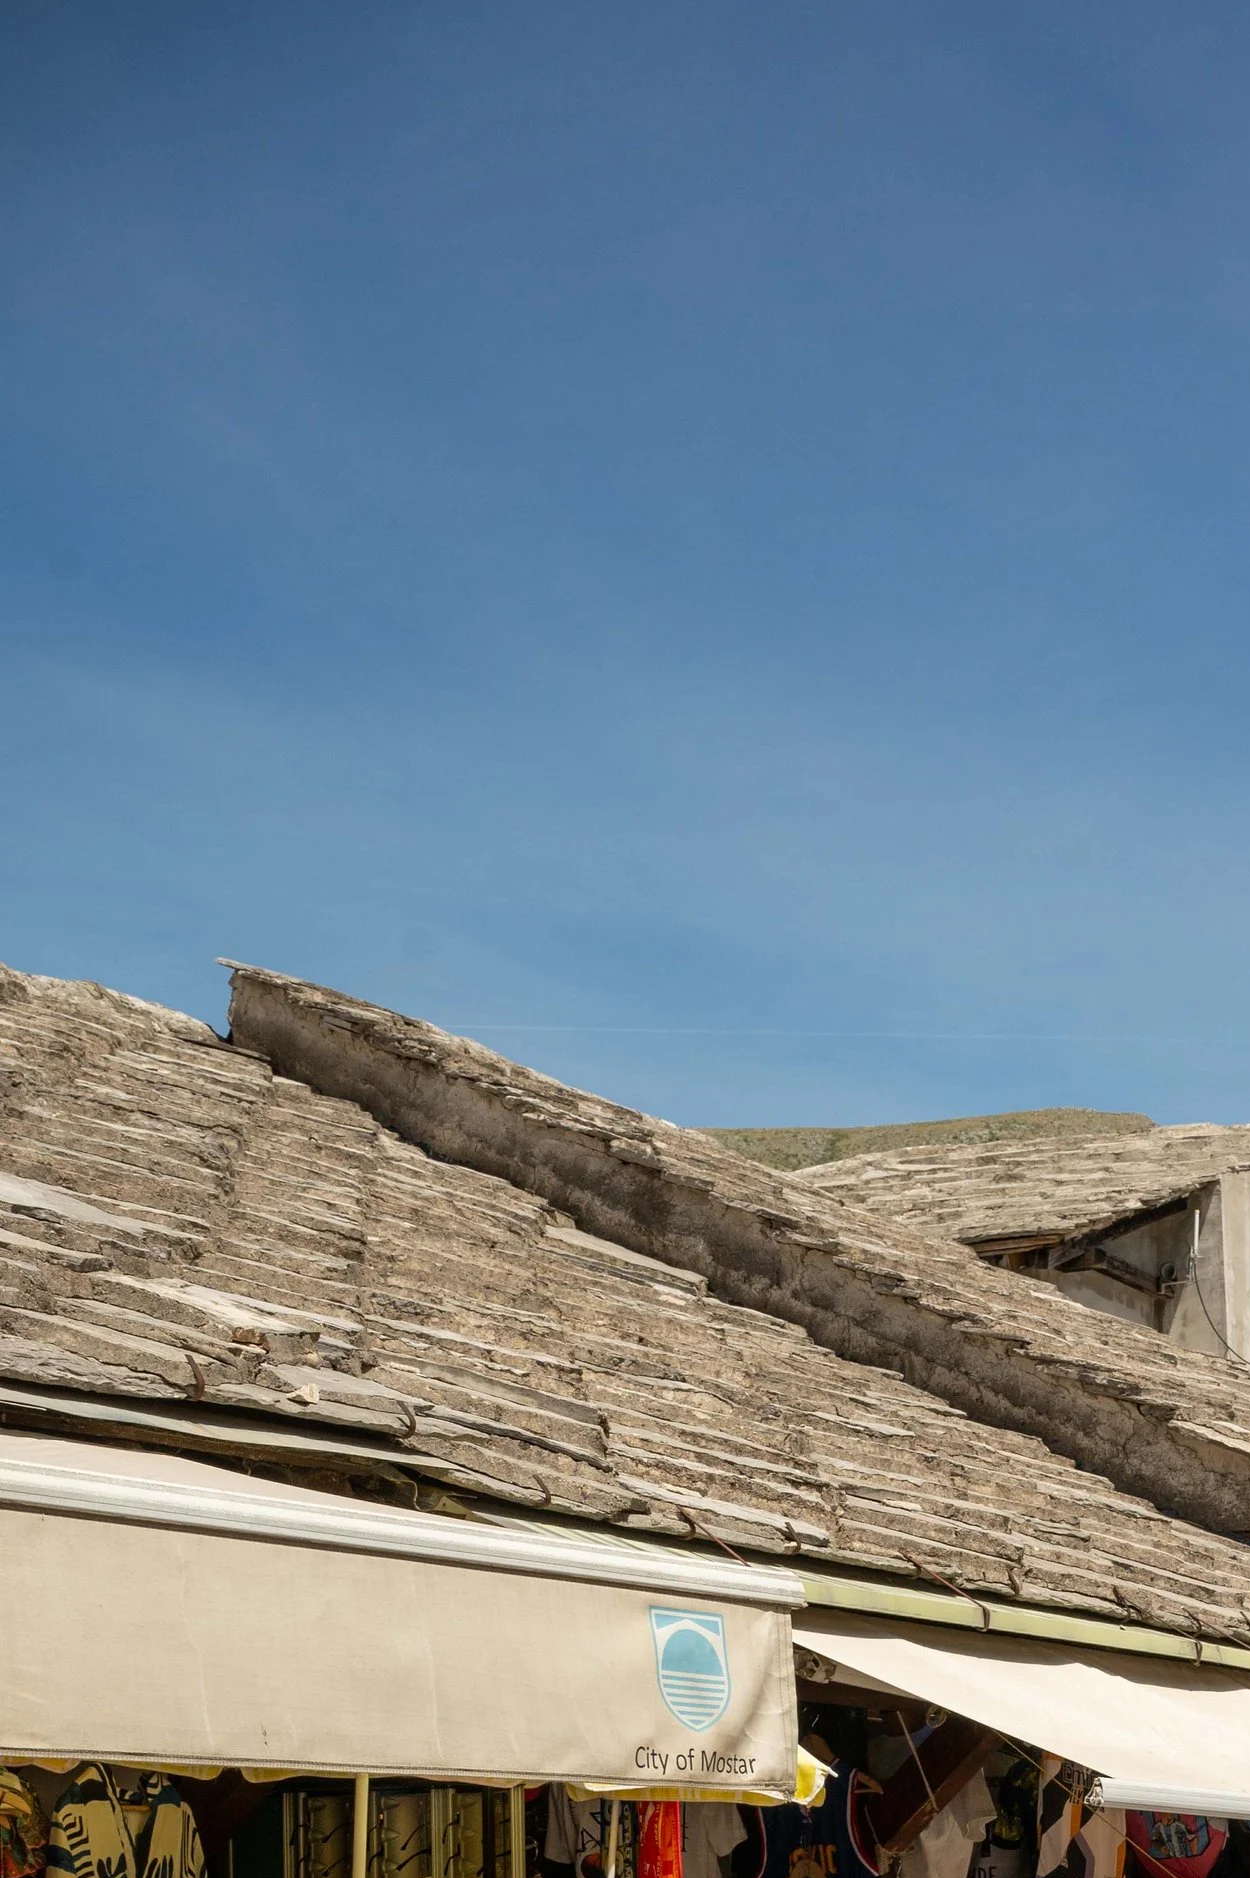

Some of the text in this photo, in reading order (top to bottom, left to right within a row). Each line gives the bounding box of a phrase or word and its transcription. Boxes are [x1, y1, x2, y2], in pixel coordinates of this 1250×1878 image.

[635, 1746, 756, 1775] City of Mostar
